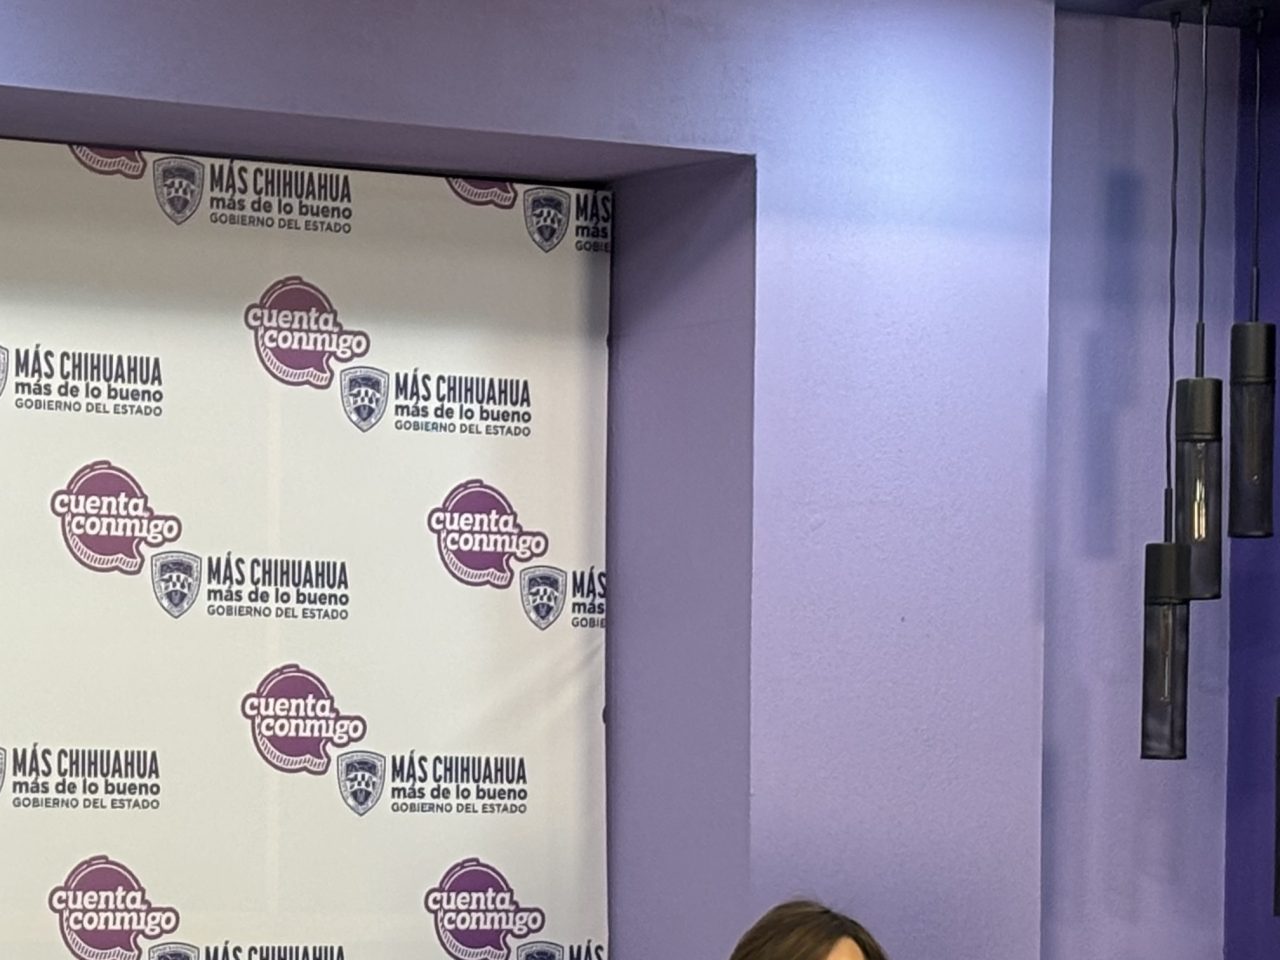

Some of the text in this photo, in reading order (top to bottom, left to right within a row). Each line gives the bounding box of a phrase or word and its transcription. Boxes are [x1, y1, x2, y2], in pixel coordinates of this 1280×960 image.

[248, 308, 334, 332] cuenta
[264, 330, 367, 358] conmigo
[15, 344, 162, 386] MÁS CHIHUAHUA
[15, 378, 163, 403] más de lo bueno
[15, 398, 162, 417] GOBIERNO DEL ESTADO
[431, 510, 513, 533] cuenta
[446, 532, 545, 558] conmigo
[207, 551, 348, 590] MÁS CHIHUAHUA
[207, 585, 349, 606] más de lo bueno
[207, 605, 348, 620] GOBIERNO DEL ESTADO
[245, 694, 331, 718] cuenta
[261, 718, 363, 743] conmigo
[391, 749, 527, 784] MÁS CHIHUAHUA
[391, 783, 528, 800] más de lo bueno
[391, 802, 527, 814] GOBIERNO DEL ESTADO
[428, 888, 510, 910] cuenta
[444, 912, 542, 934] conmigo
